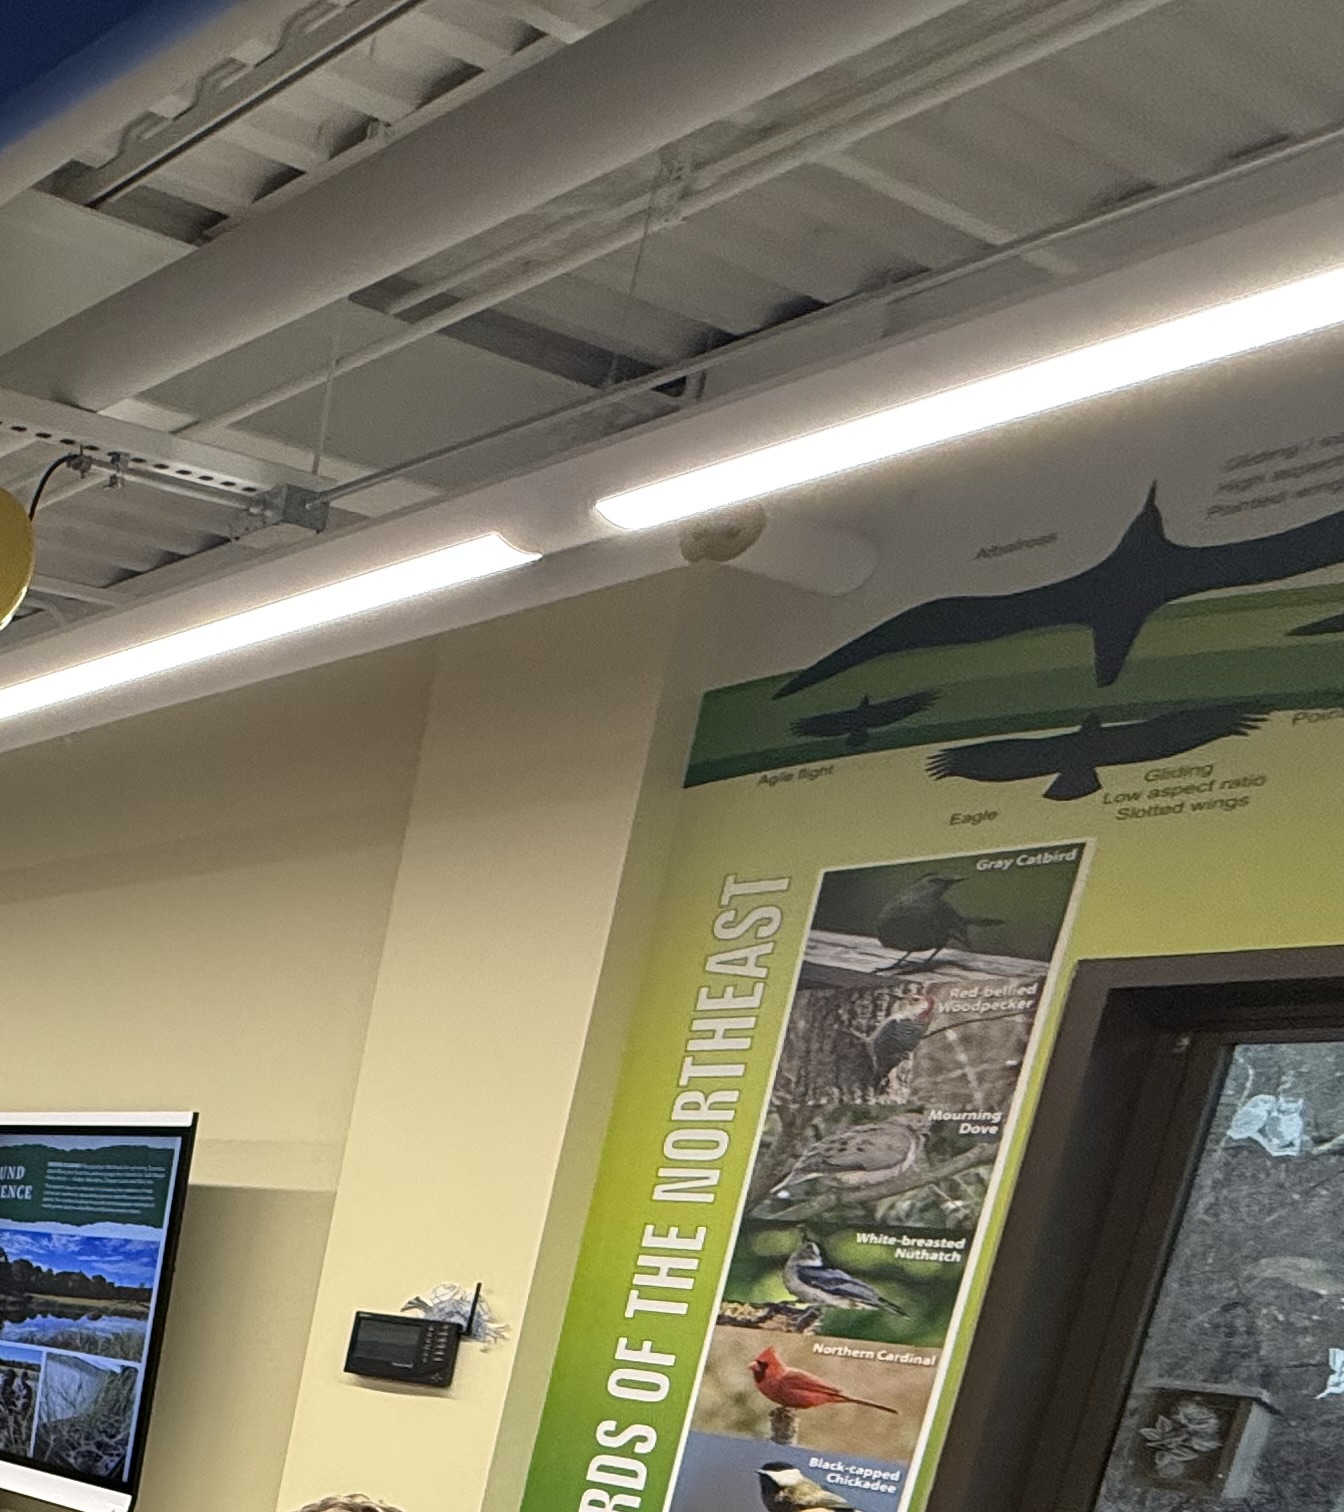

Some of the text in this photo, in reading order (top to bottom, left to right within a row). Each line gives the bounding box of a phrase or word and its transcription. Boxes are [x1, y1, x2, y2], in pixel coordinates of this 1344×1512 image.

[758, 764, 834, 788] Agile flight
[1143, 763, 1214, 784] Gliding
[1103, 773, 1268, 805] Low aspect ratio
[949, 809, 1000, 826] Eagle
[1115, 792, 1250, 821] Slotted wings
[976, 848, 1078, 872] Gray Catbird
[949, 982, 1039, 999] Red-bellied
[938, 999, 1035, 1013] Woodpecker
[651, 873, 792, 1204] NORTHEAST
[927, 1109, 1002, 1123] Mourning
[958, 1123, 999, 1134] Dove
[856, 1232, 966, 1250] White-breasted
[894, 1248, 962, 1263] Nuthatch
[624, 1223, 707, 1319] THE
[812, 1342, 936, 1366] Northern Cardinal
[607, 1336, 677, 1403] OF
[809, 1457, 901, 1482] Black-capped
[826, 1473, 897, 1494] Chickadee
